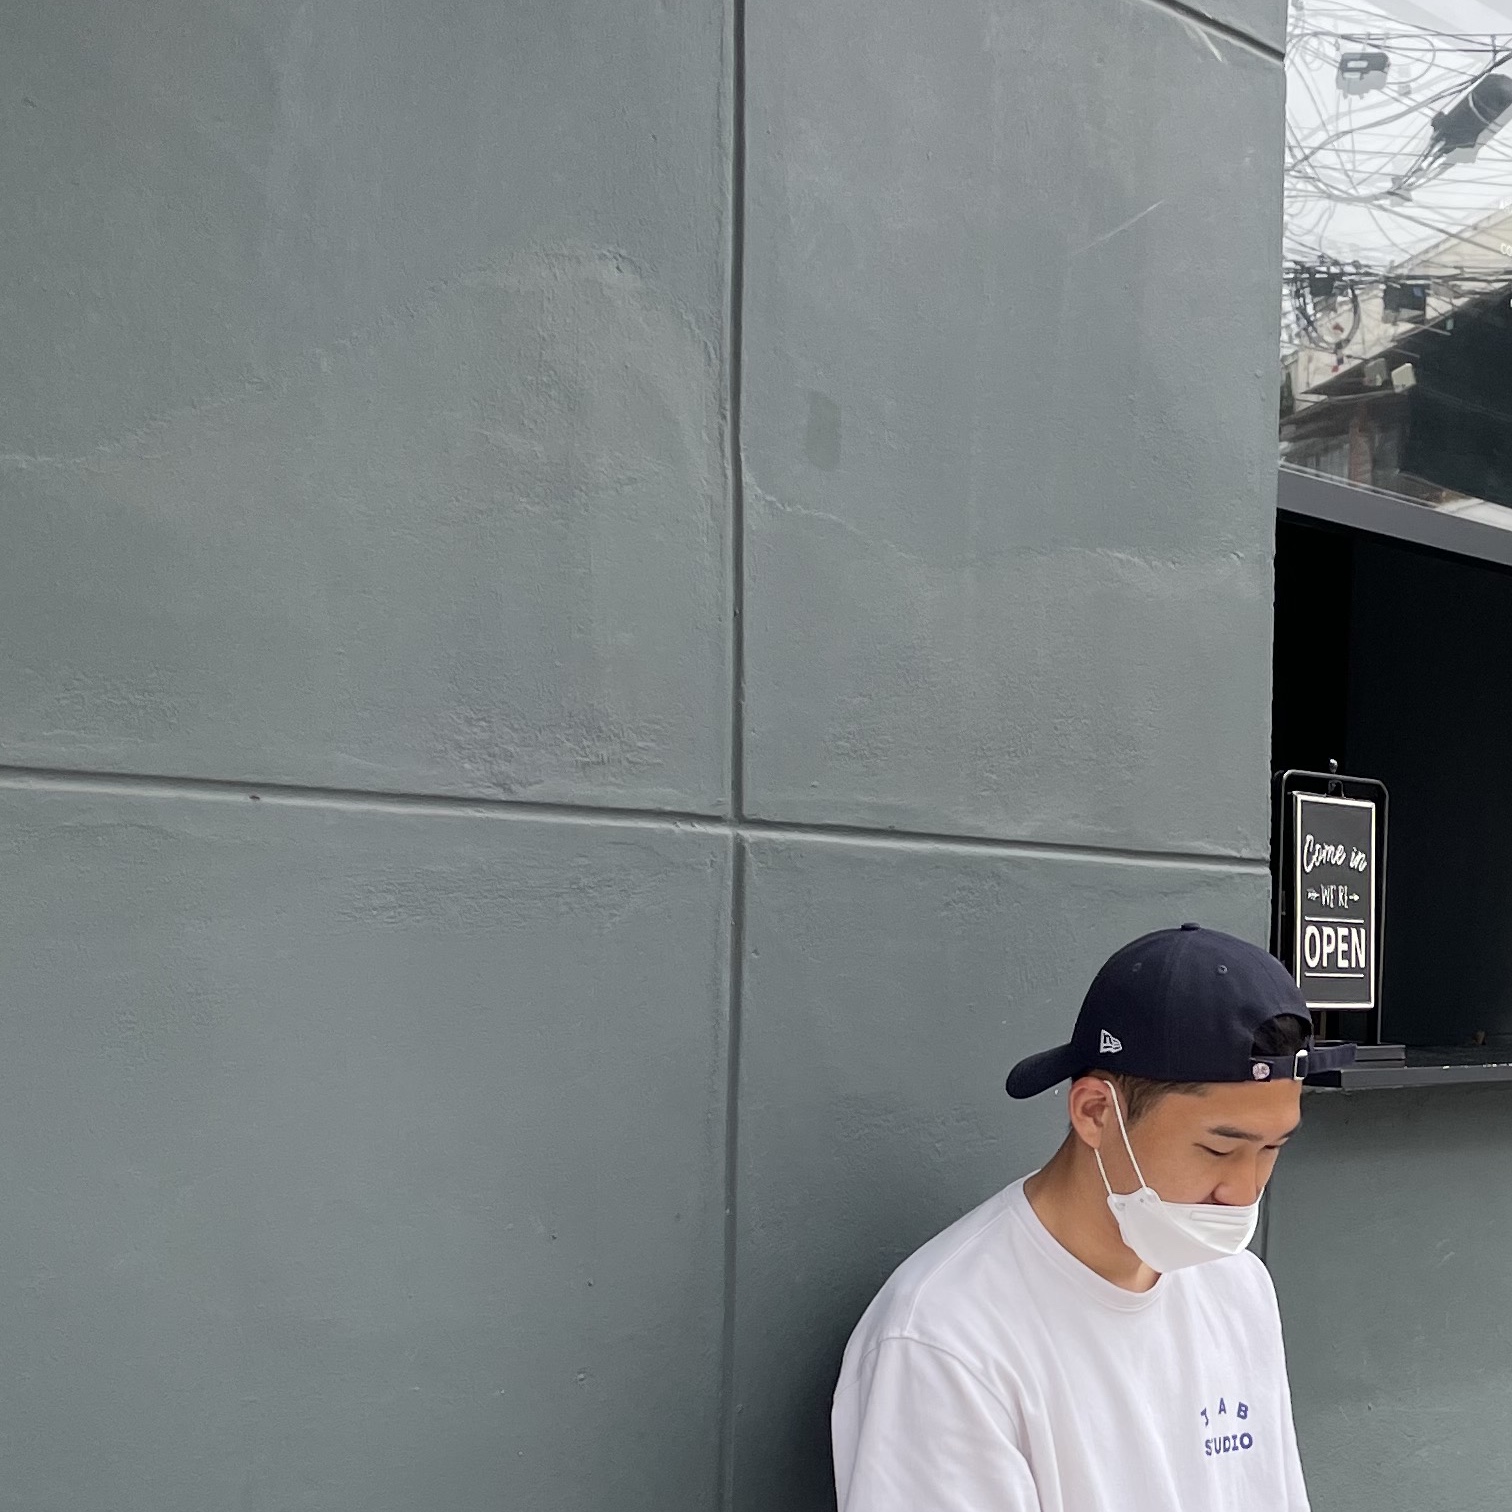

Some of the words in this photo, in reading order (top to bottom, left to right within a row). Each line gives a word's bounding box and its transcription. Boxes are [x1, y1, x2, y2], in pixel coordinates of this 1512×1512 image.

[1302, 833, 1347, 874] Come
[1349, 846, 1368, 873] in
[1304, 925, 1366, 969] OPEN
